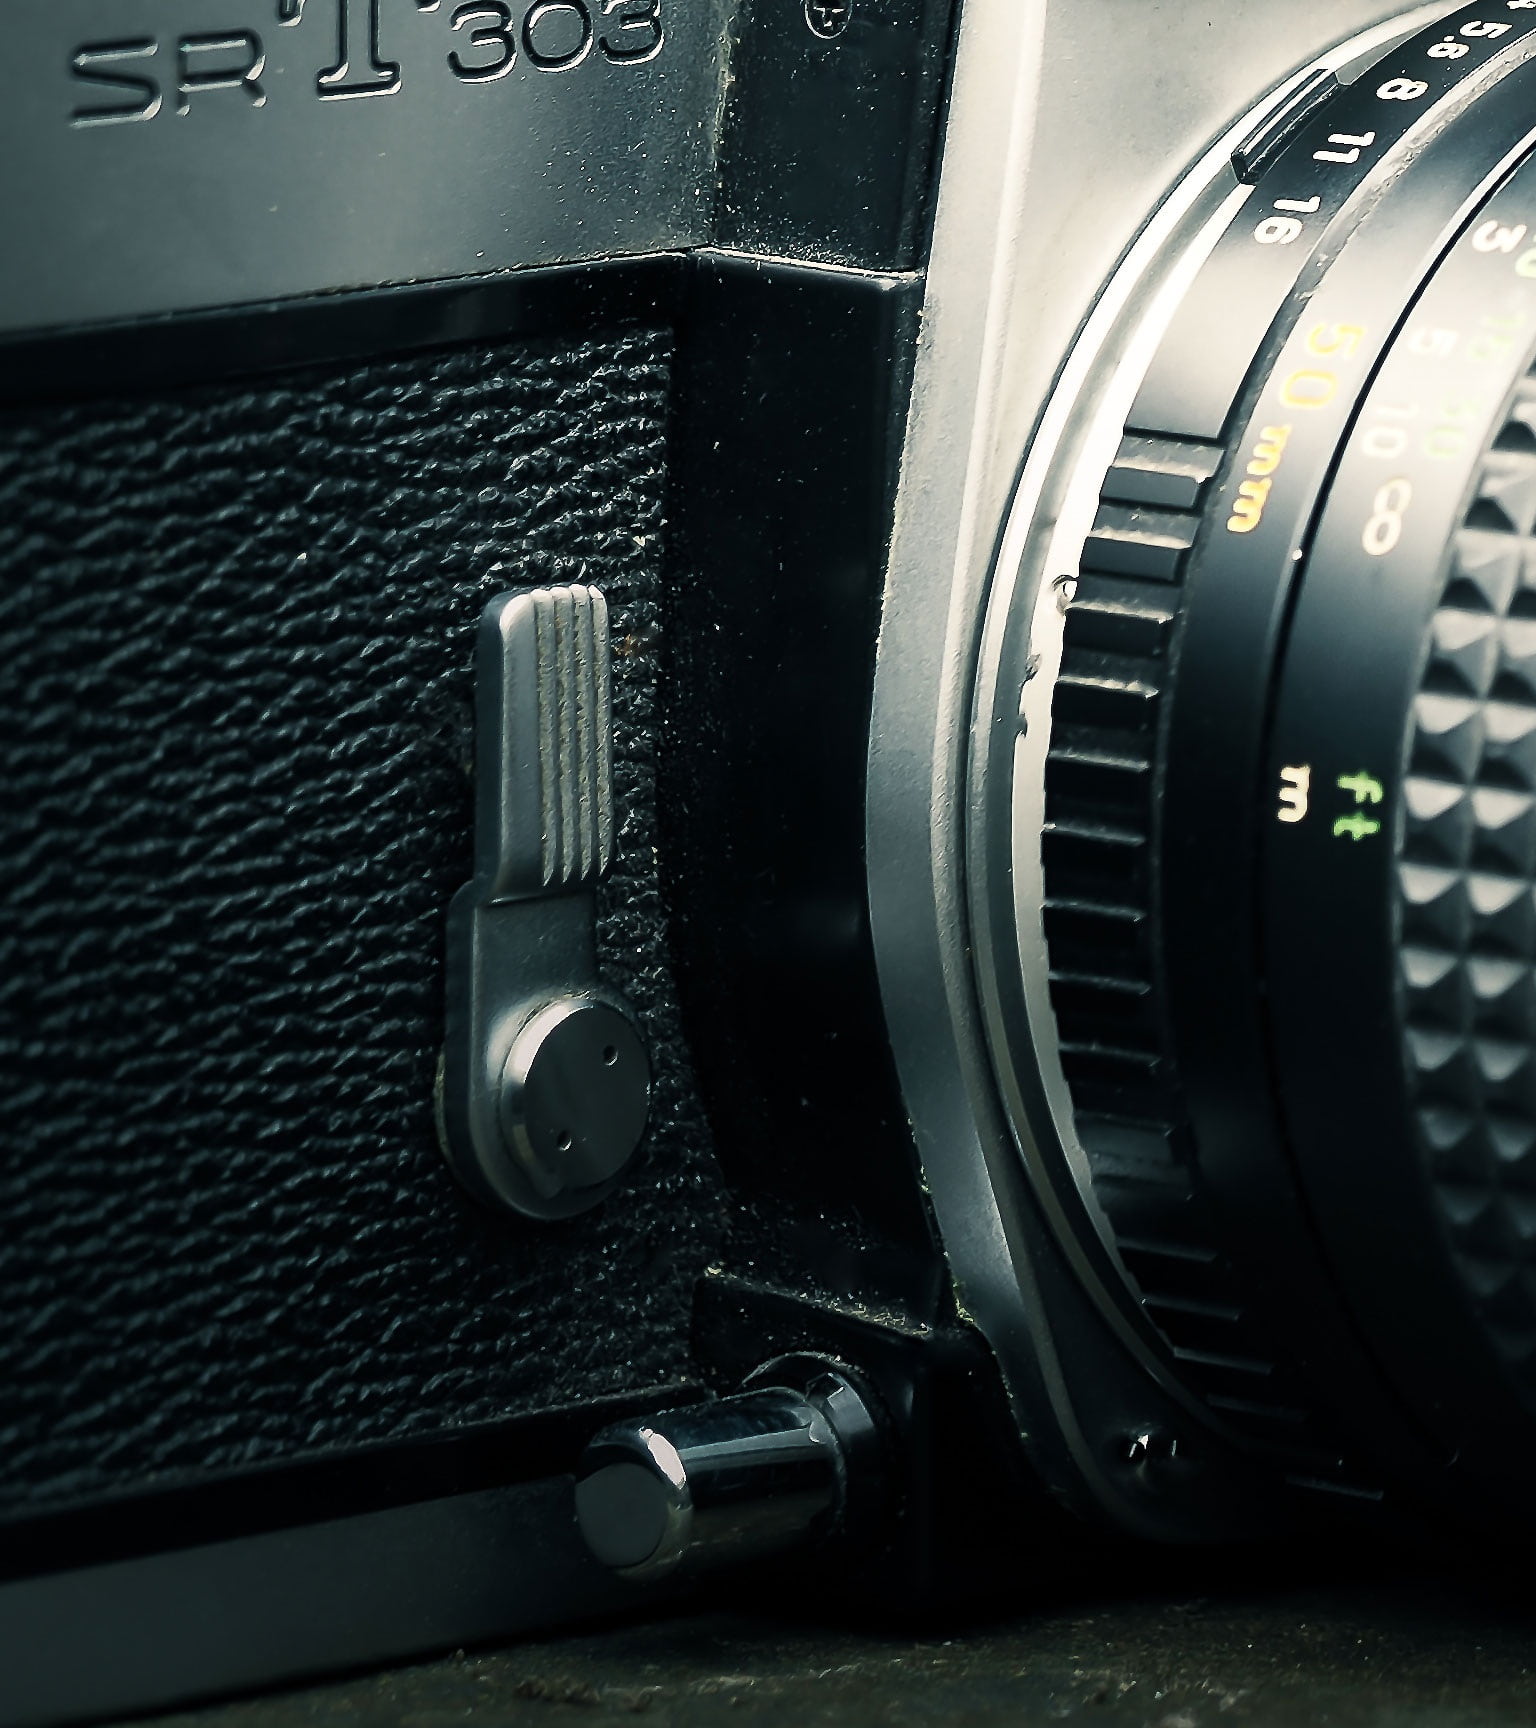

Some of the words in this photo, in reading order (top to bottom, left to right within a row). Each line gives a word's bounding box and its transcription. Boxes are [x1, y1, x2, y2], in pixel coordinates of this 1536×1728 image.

[1426, 19, 1510, 61] 5.6
[1376, 76, 1428, 103] 8
[1313, 129, 1376, 166] 11
[1253, 194, 1322, 246] 16
[1471, 222, 1523, 255] 3
[1361, 402, 1420, 459] 10
[1276, 763, 1312, 824] m
[1332, 770, 1384, 840] ft
